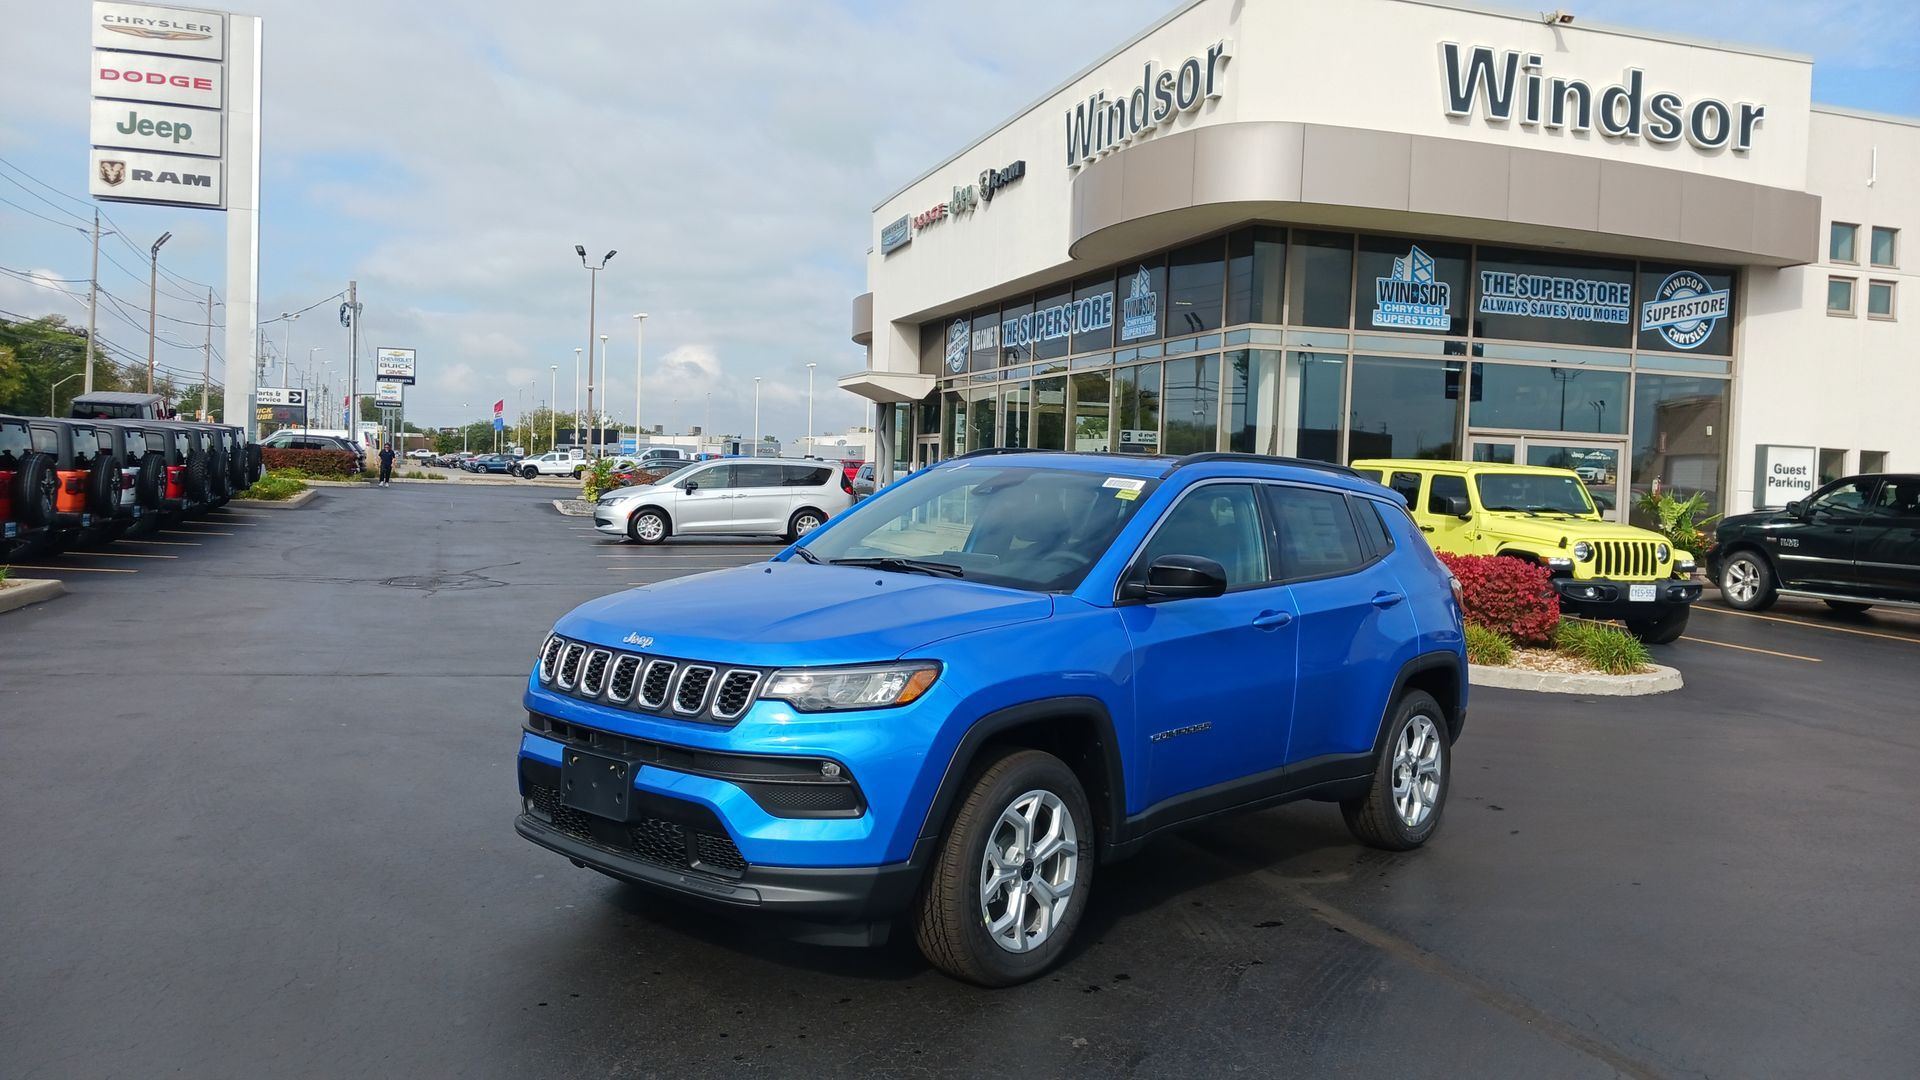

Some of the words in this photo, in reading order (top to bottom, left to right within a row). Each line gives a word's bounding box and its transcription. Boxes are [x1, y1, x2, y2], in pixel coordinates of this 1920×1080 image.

[103, 14, 211, 33] CHRYSLER
[100, 68, 213, 91] DODGE
[1064, 38, 1234, 169] Windsor
[1439, 41, 1766, 152] Windsor
[116, 111, 193, 144] Jeep
[131, 169, 212, 188] RAM
[991, 160, 1025, 188] RAM
[1378, 280, 1448, 306] WINDSOR
[1483, 273, 1515, 295] THE
[1518, 276, 1629, 305] SUPERSTORE
[1663, 276, 1704, 297] WINDSOR
[1125, 294, 1156, 318] WINDSOR
[1383, 304, 1441, 315] CHRYSLER
[1482, 298, 1528, 313] ALWAYS
[1531, 302, 1567, 317] SAVES
[1570, 305, 1592, 319] YOU
[1594, 307, 1629, 322] MORE!
[1645, 298, 1726, 323] SUPERSTORE
[1002, 321, 1018, 347] THE
[1019, 296, 1113, 344] SUPERSTORE
[1376, 314, 1449, 326] SUPERSTORE
[1668, 322, 1709, 344] CHRYSLER
[1773, 463, 1807, 476] Guest
[1768, 476, 1811, 491] Parking
[623, 631, 654, 648] Jeep
